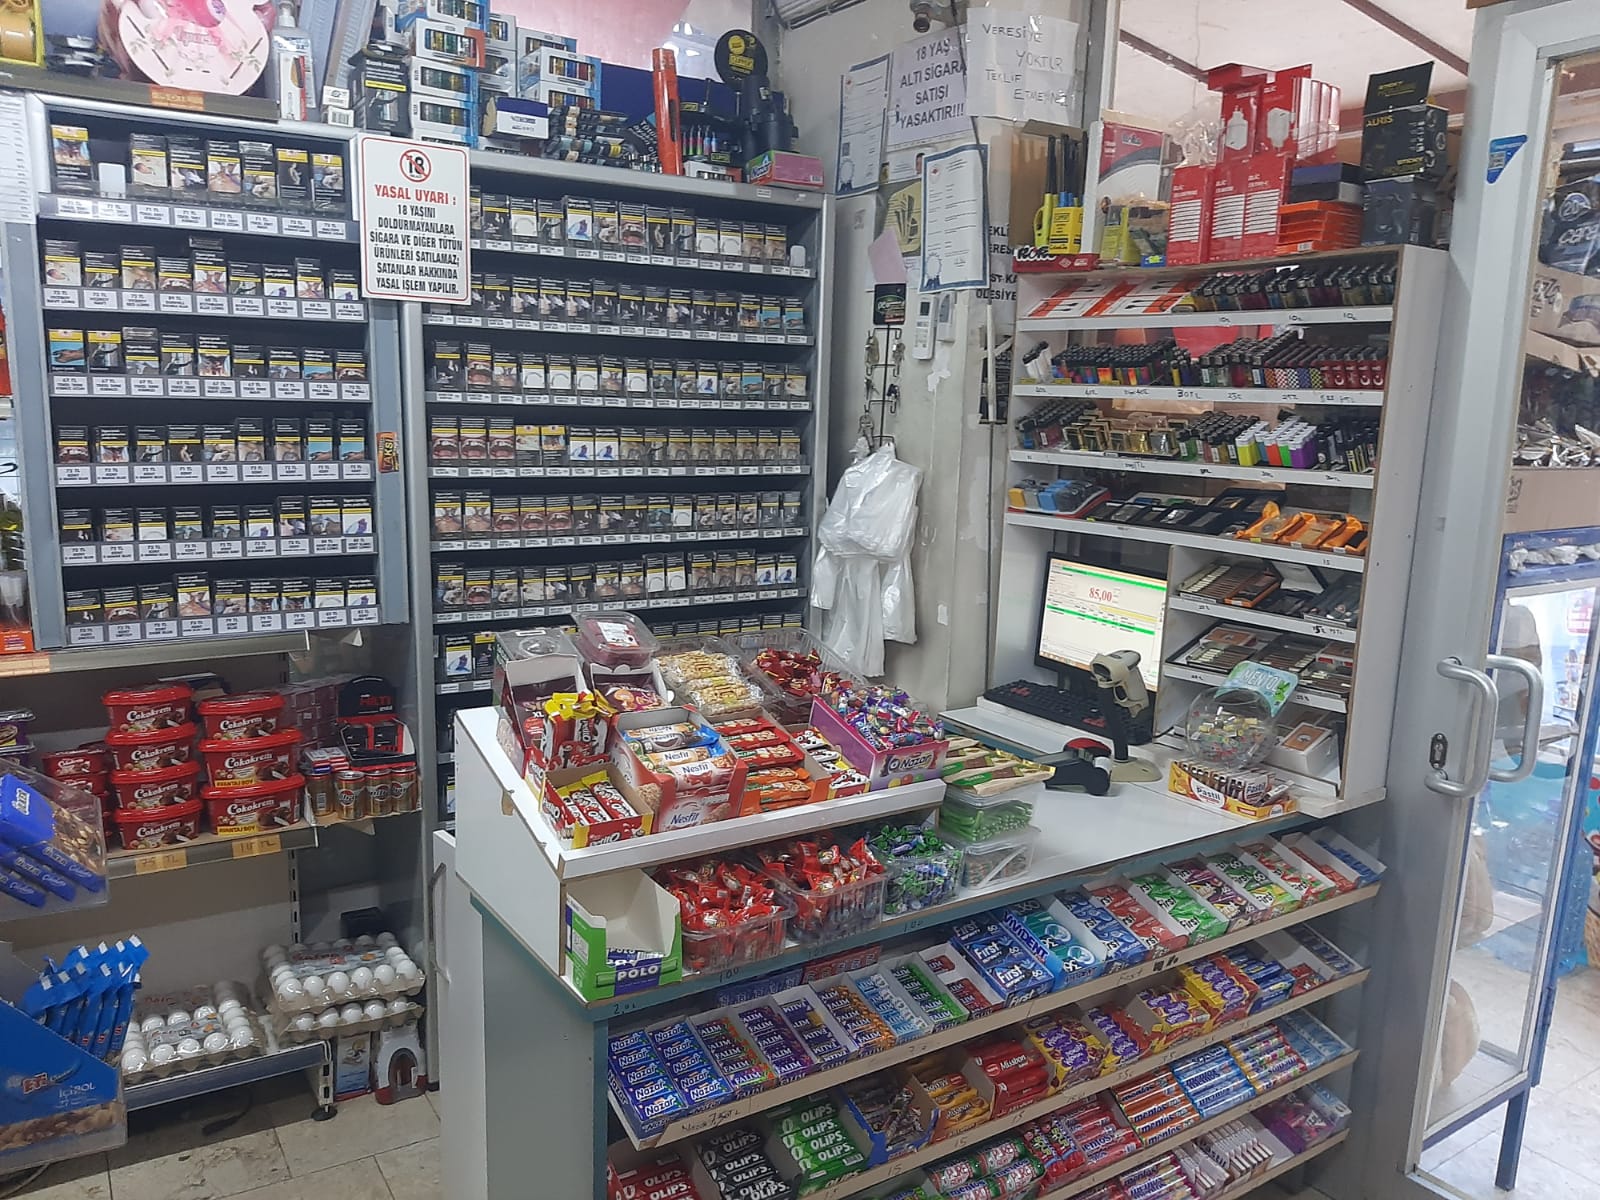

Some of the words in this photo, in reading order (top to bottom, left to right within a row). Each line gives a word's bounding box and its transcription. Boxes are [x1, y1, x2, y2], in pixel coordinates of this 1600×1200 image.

[916, 47, 927, 61] 18
[929, 39, 951, 58] YAŞ
[900, 71, 922, 88] ALTI
[925, 60, 966, 81] SİGARA
[916, 85, 948, 105] SATIŞI
[899, 103, 964, 129] YASAKTIR!!!
[375, 184, 411, 200] YASAL
[416, 189, 448, 204] UYARI
[398, 204, 407, 215] 18
[411, 206, 435, 220] YAŞINI
[378, 217, 454, 234] DOLDURMAYANLARA
[370, 228, 398, 243] SİGARA
[401, 234, 411, 245] VE
[414, 233, 436, 248] DİĞER
[439, 235, 462, 250] TÜTÜN
[374, 244, 413, 260] ÜRÜNLERİ
[416, 251, 459, 266] SATILAMAZ;
[377, 262, 416, 276] SATANLAR
[419, 266, 457, 279] HAKKINDA
[376, 277, 400, 289] YASAL
[402, 277, 426, 293] İŞLEM
[429, 282, 459, 294] YAPILIR.
[1089, 587, 1112, 601] 85,00
[665, 752, 689, 760] Nesfit
[901, 754, 933, 768] Nazar
[682, 764, 708, 772] Nesfit
[1196, 786, 1221, 801] Pastil
[671, 813, 699, 824] Nesfit
[1180, 917, 1199, 931] First
[1003, 911, 1049, 957] VIVIDENT
[974, 942, 1000, 959] First
[617, 965, 658, 981] POLO
[998, 965, 1023, 983] First
[930, 1011, 951, 1021] FALIM
[655, 1023, 681, 1041] Nazar
[857, 1031, 881, 1043] FALIM
[611, 1032, 640, 1051] Nazar
[664, 1039, 691, 1057] Nazar
[619, 1047, 648, 1066] Nazar
[672, 1053, 700, 1073] Nazar
[627, 1063, 657, 1082] Nazar
[723, 1060, 750, 1072] FALIM
[775, 1061, 802, 1074] FALIM
[681, 1069, 709, 1088] Nazar
[734, 1072, 761, 1085] FALIM
[635, 1079, 665, 1099] Nazar
[690, 1080, 720, 1100] Nazar
[645, 1094, 676, 1116] Nazar
[1134, 1105, 1167, 1122] mentos
[1141, 1116, 1174, 1133] mentos
[1083, 1136, 1112, 1152] entos
[1148, 1127, 1182, 1145] mentos
